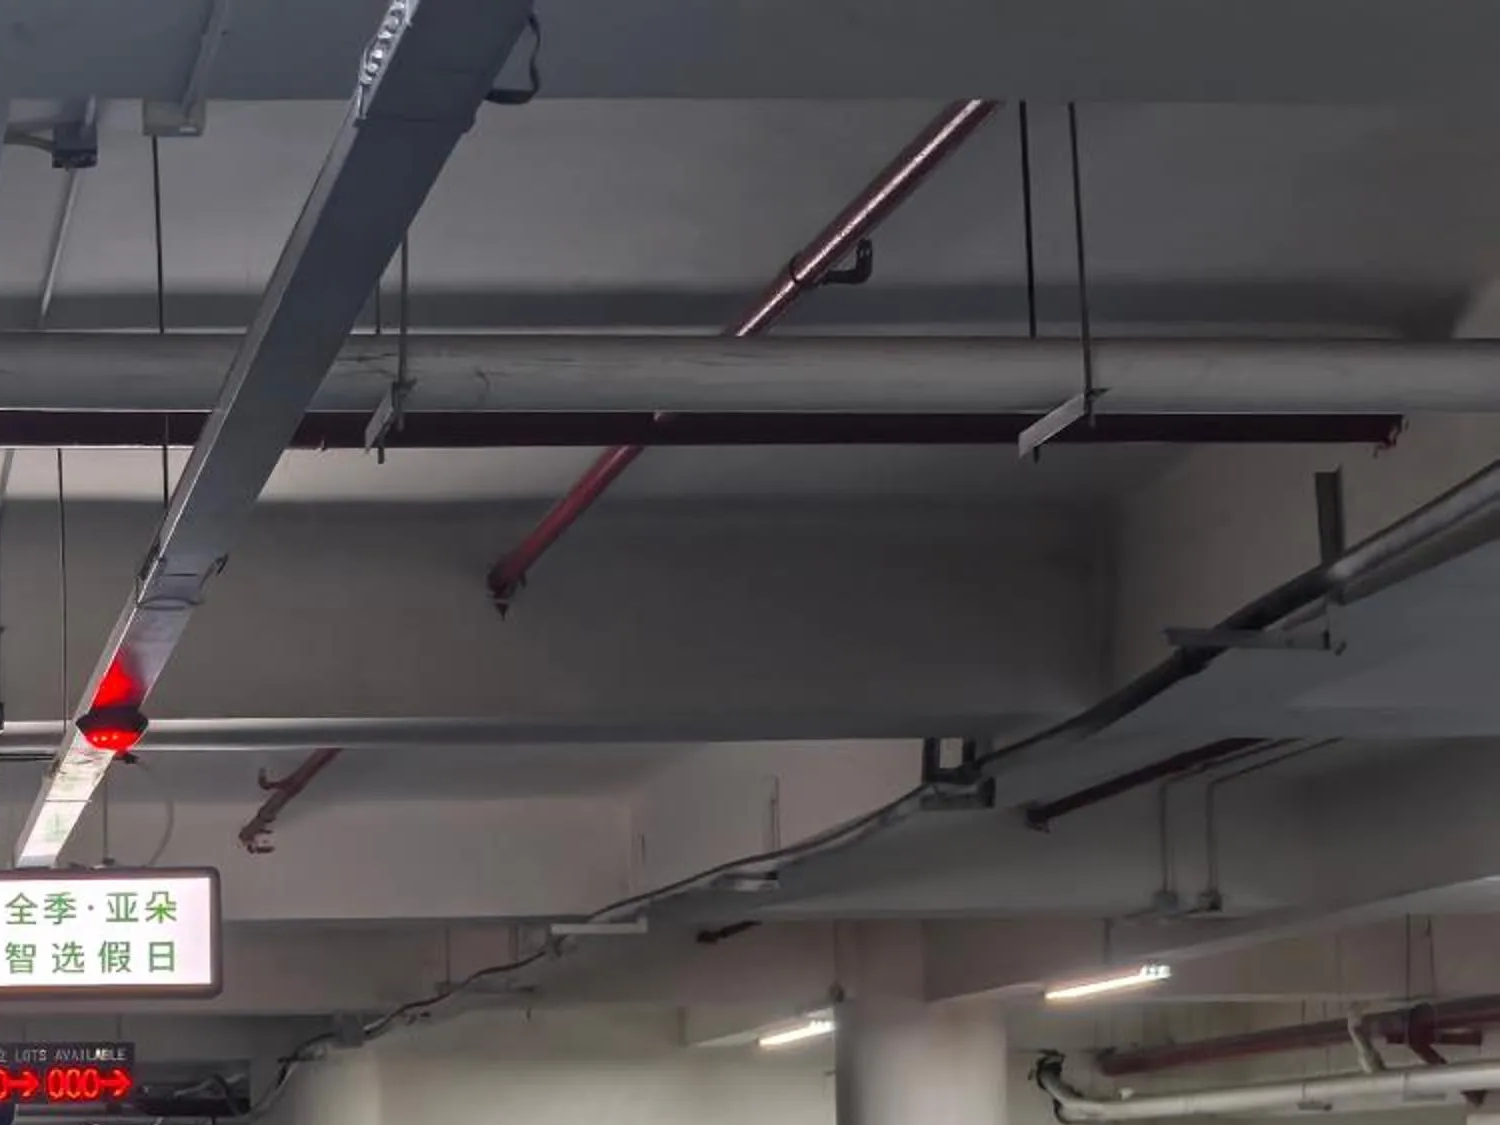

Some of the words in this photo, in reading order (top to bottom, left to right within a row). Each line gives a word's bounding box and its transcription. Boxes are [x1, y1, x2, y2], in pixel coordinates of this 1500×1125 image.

[15, 1048, 47, 1063] LOTS
[55, 1047, 127, 1062] AVAILABLE
[48, 1068, 100, 1099] 000
